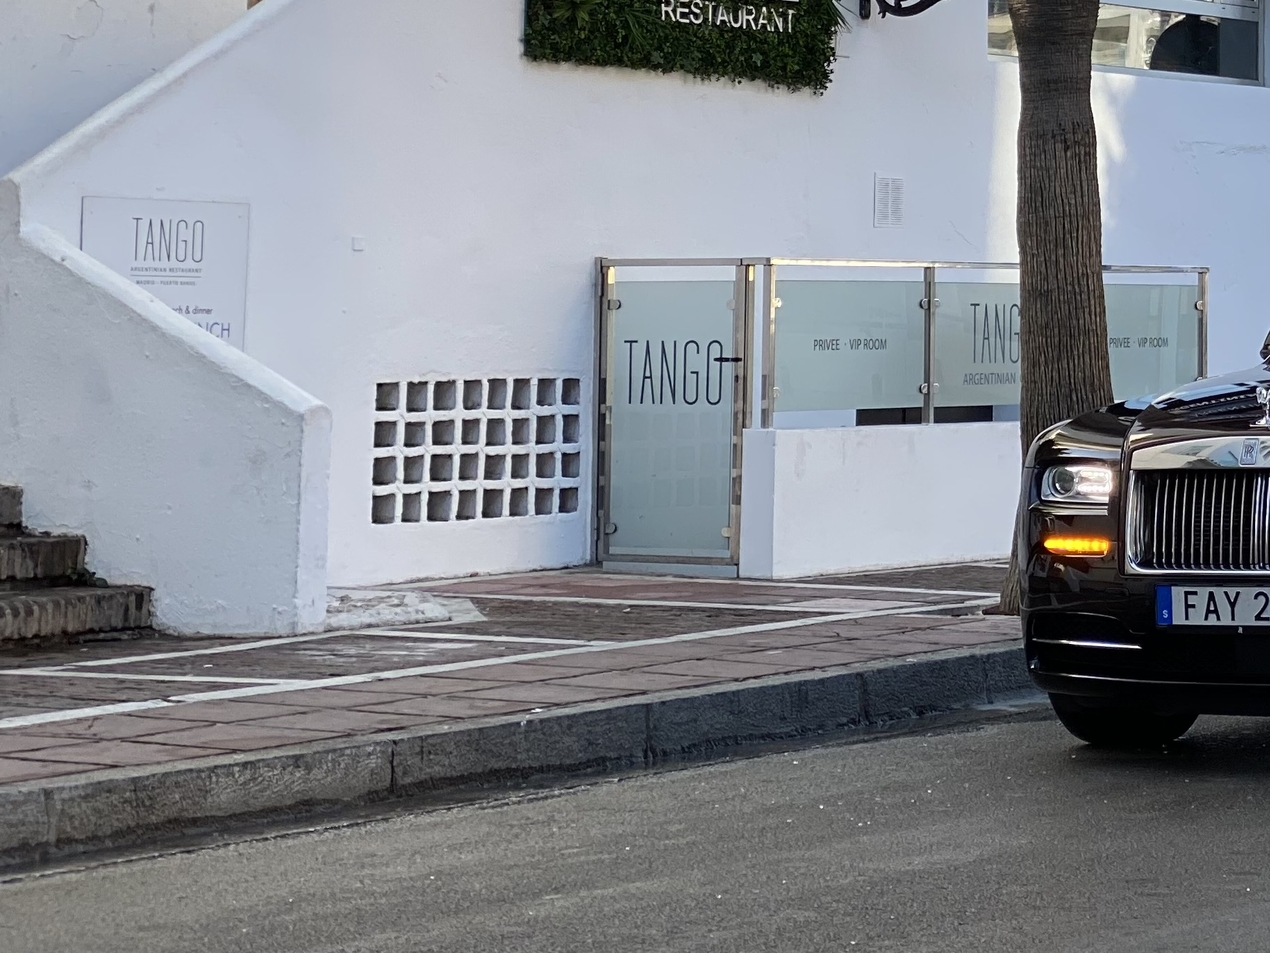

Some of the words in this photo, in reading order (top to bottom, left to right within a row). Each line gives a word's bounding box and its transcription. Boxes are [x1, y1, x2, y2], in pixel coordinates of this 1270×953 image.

[132, 217, 204, 263] TANGO
[192, 305, 213, 314] dinner
[813, 338, 841, 351] PRIVEE
[849, 338, 862, 350] VIP
[863, 338, 888, 350] ROOM
[1109, 337, 1130, 348] PRIVEE
[1138, 337, 1148, 348] VIP
[1149, 337, 1169, 348] ROOM
[624, 340, 723, 405] TANGO
[963, 372, 1016, 386] ARGENTINIAN
[1162, 610, 1169, 618] S
[1183, 590, 1241, 622] FAY
